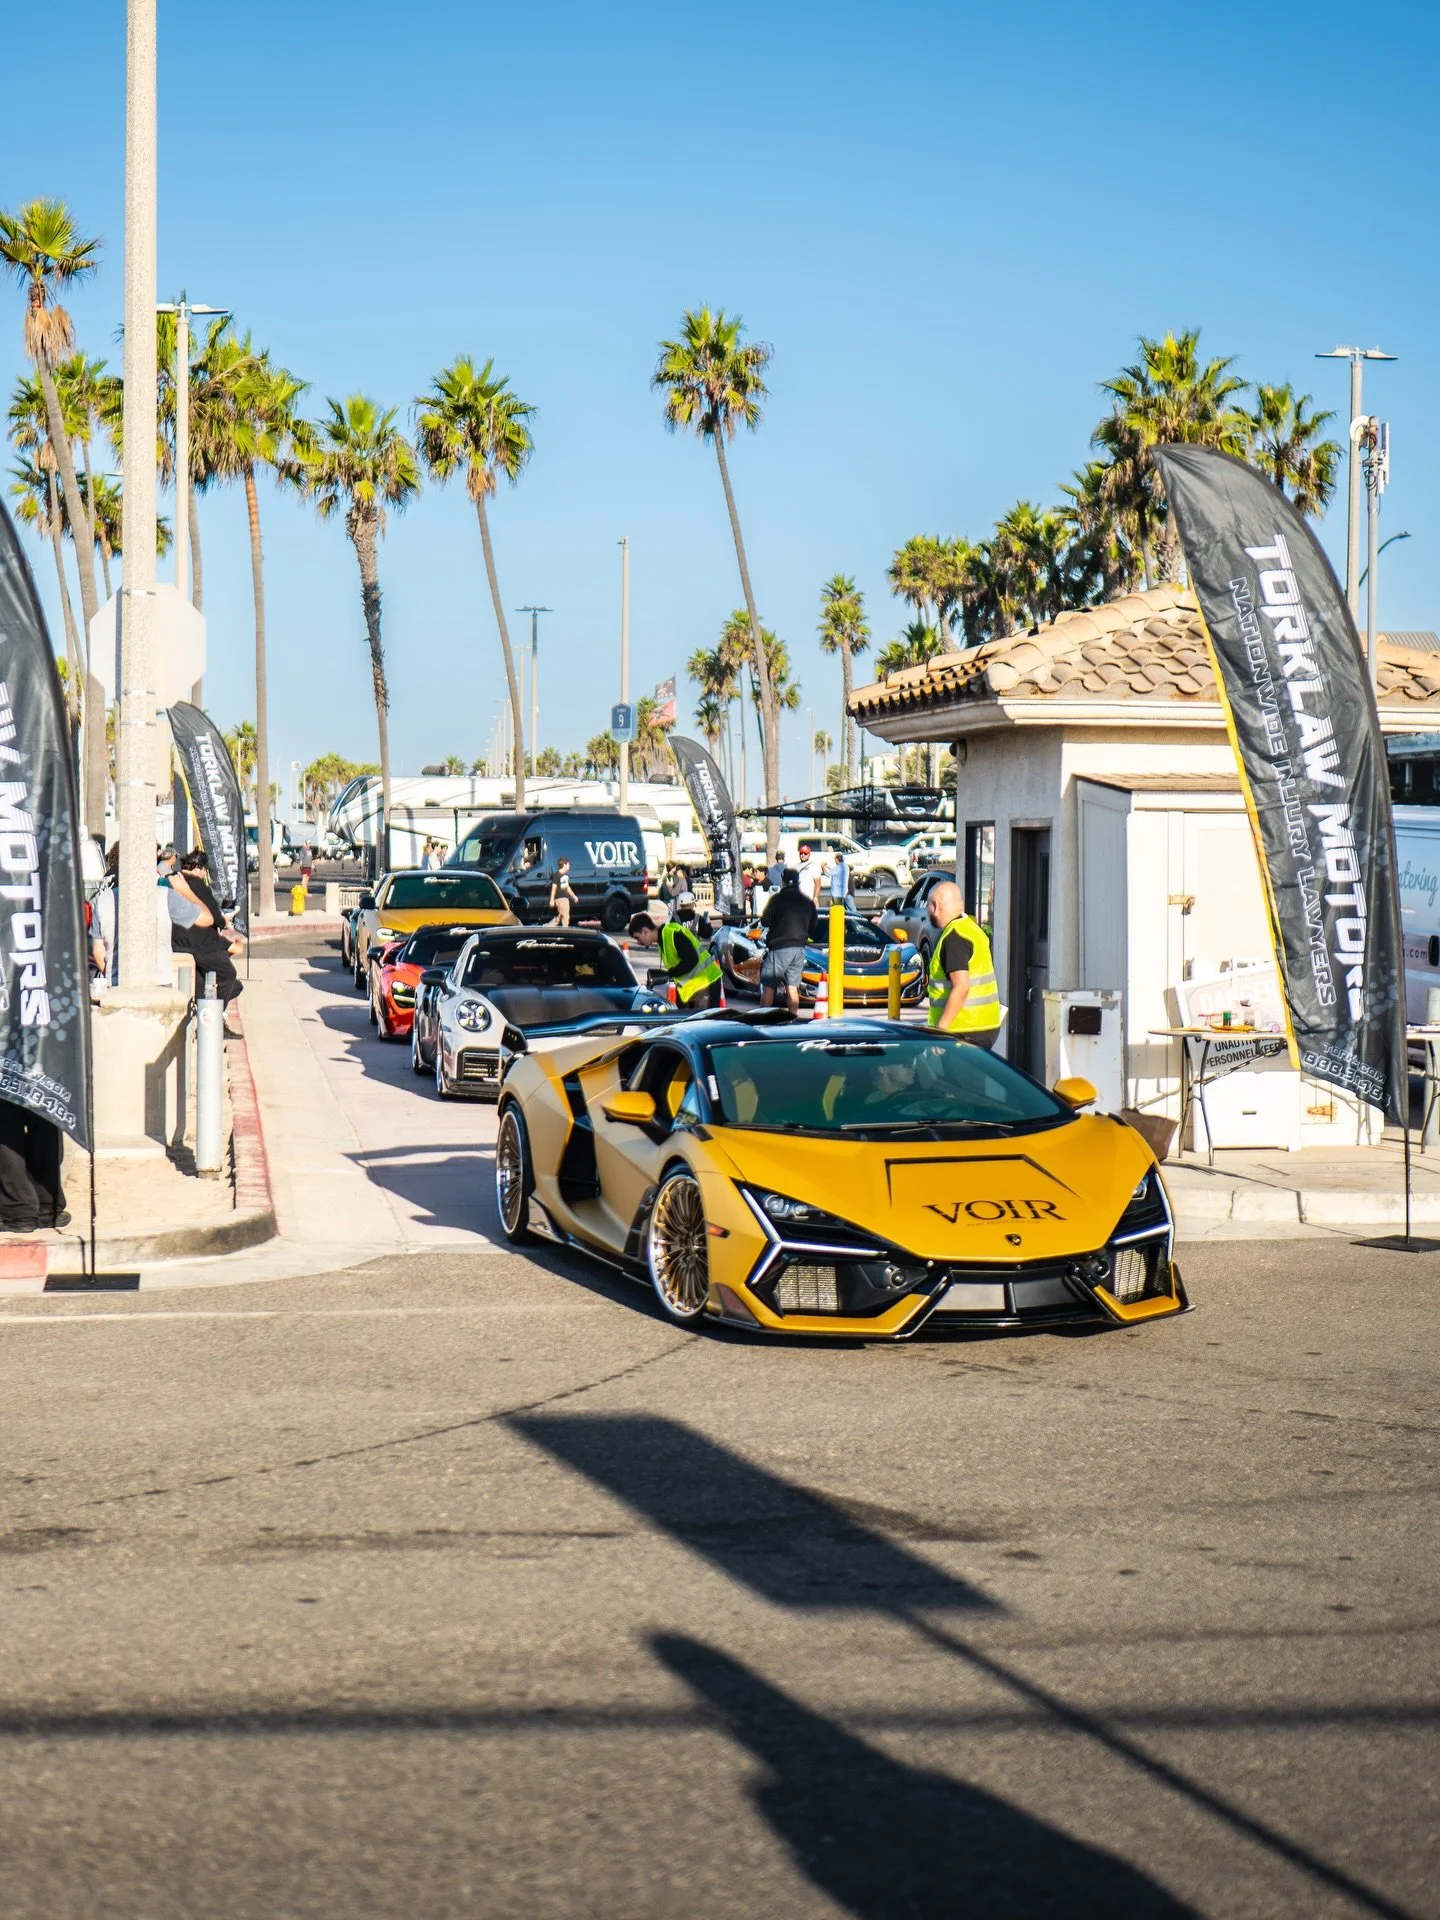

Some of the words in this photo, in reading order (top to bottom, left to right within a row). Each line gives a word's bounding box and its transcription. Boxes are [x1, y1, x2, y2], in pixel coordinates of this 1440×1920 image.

[1244, 533, 1346, 789] TORKLAW
[618, 713, 626, 727] 9
[195, 732, 231, 822] TORKLAW
[1229, 576, 1289, 756] NATIONWIDE
[1271, 759, 1312, 861] INJURY
[1297, 866, 1337, 1006] LAWYERS
[584, 841, 640, 866] VOIR
[922, 1199, 1069, 1224] VOIR
